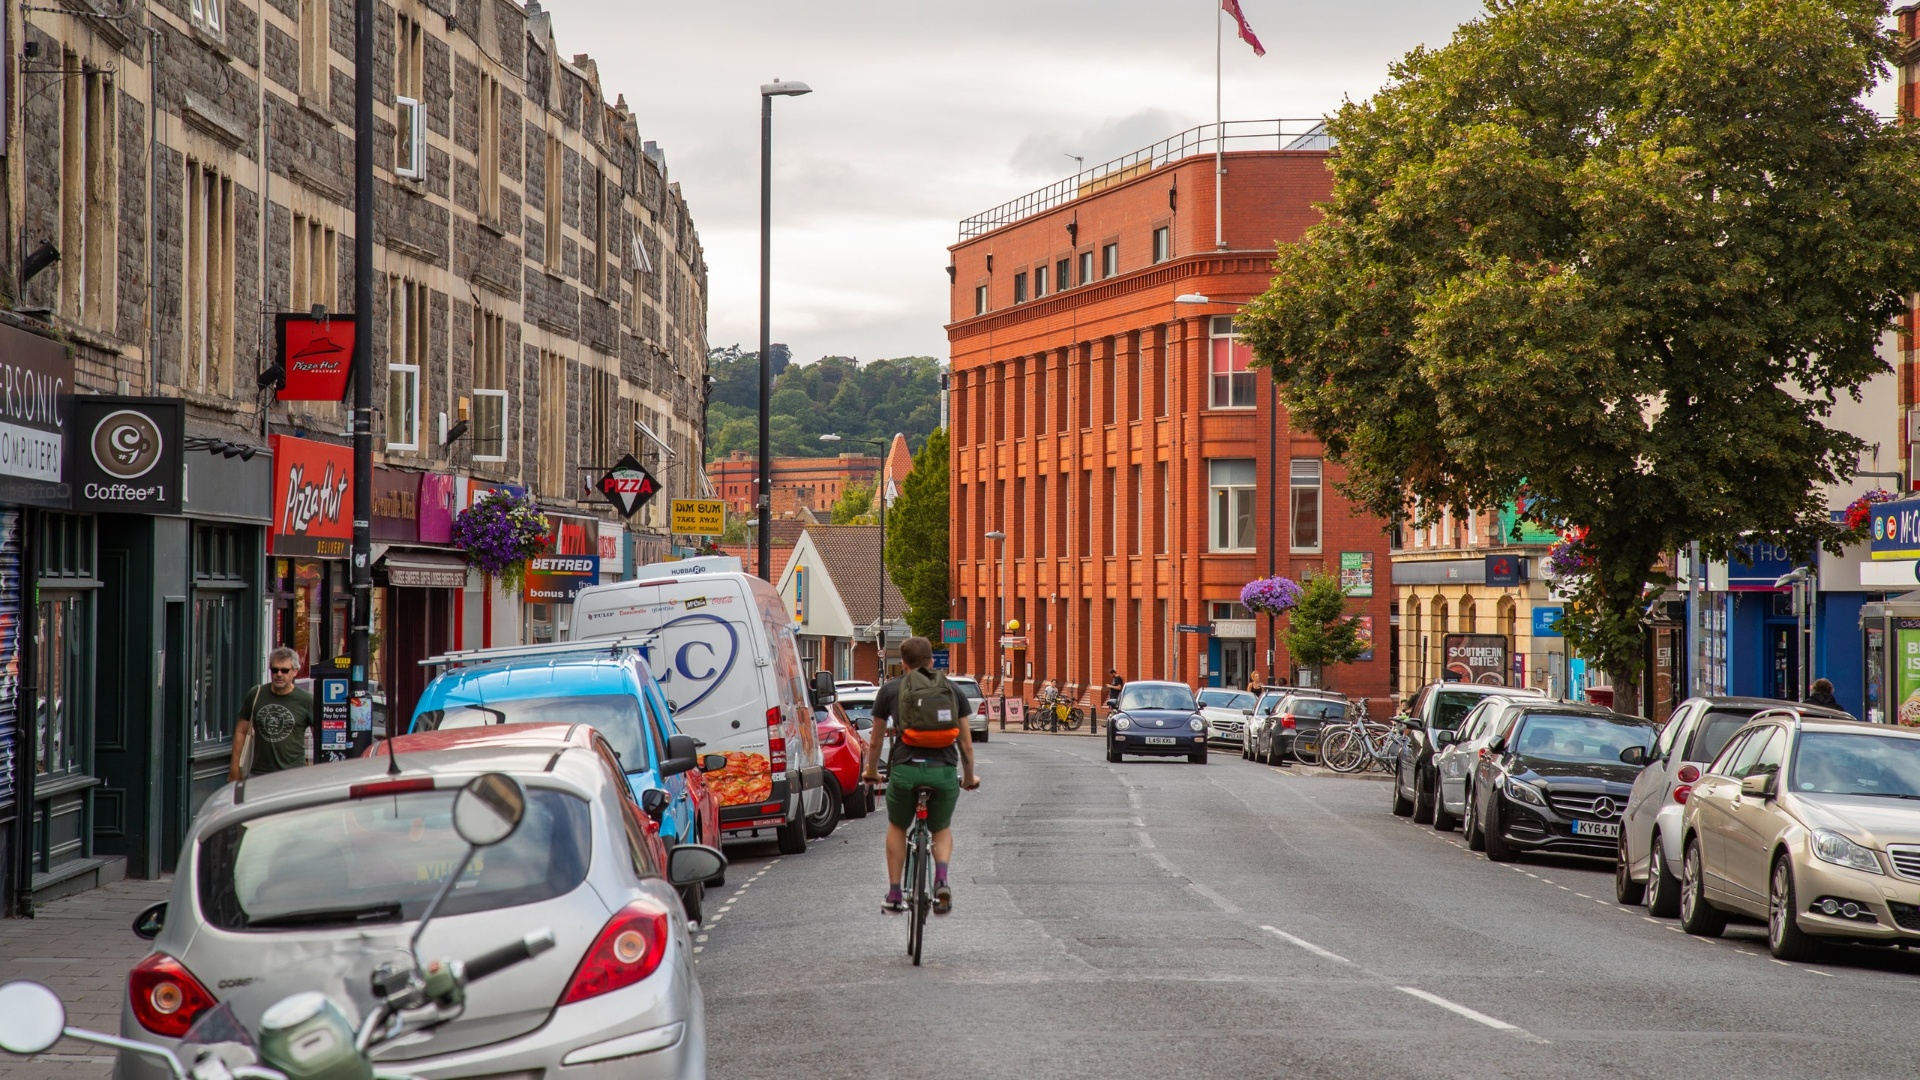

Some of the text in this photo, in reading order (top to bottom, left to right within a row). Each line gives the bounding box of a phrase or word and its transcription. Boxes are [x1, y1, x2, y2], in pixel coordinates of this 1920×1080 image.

[292, 361, 339, 371] Pizza Hut
[0, 362, 63, 428] RSONIC
[2, 432, 57, 473] OMPUTERS
[84, 482, 165, 502] Coffee#1
[604, 478, 652, 493] PIZZA
[282, 463, 319, 537] Pizza
[318, 460, 348, 526] Hut
[675, 503, 721, 513] DIM SUM
[561, 524, 586, 555] PIZZA
[316, 541, 345, 555] DELIVERY
[531, 559, 593, 571] BETFRED
[578, 580, 592, 588] the
[530, 589, 564, 598] bonus
[1448, 646, 1502, 658] SOUTHERN
[1469, 656, 1499, 667] BITES
[330, 683, 345, 700] P
[1580, 822, 1608, 834] KY64
